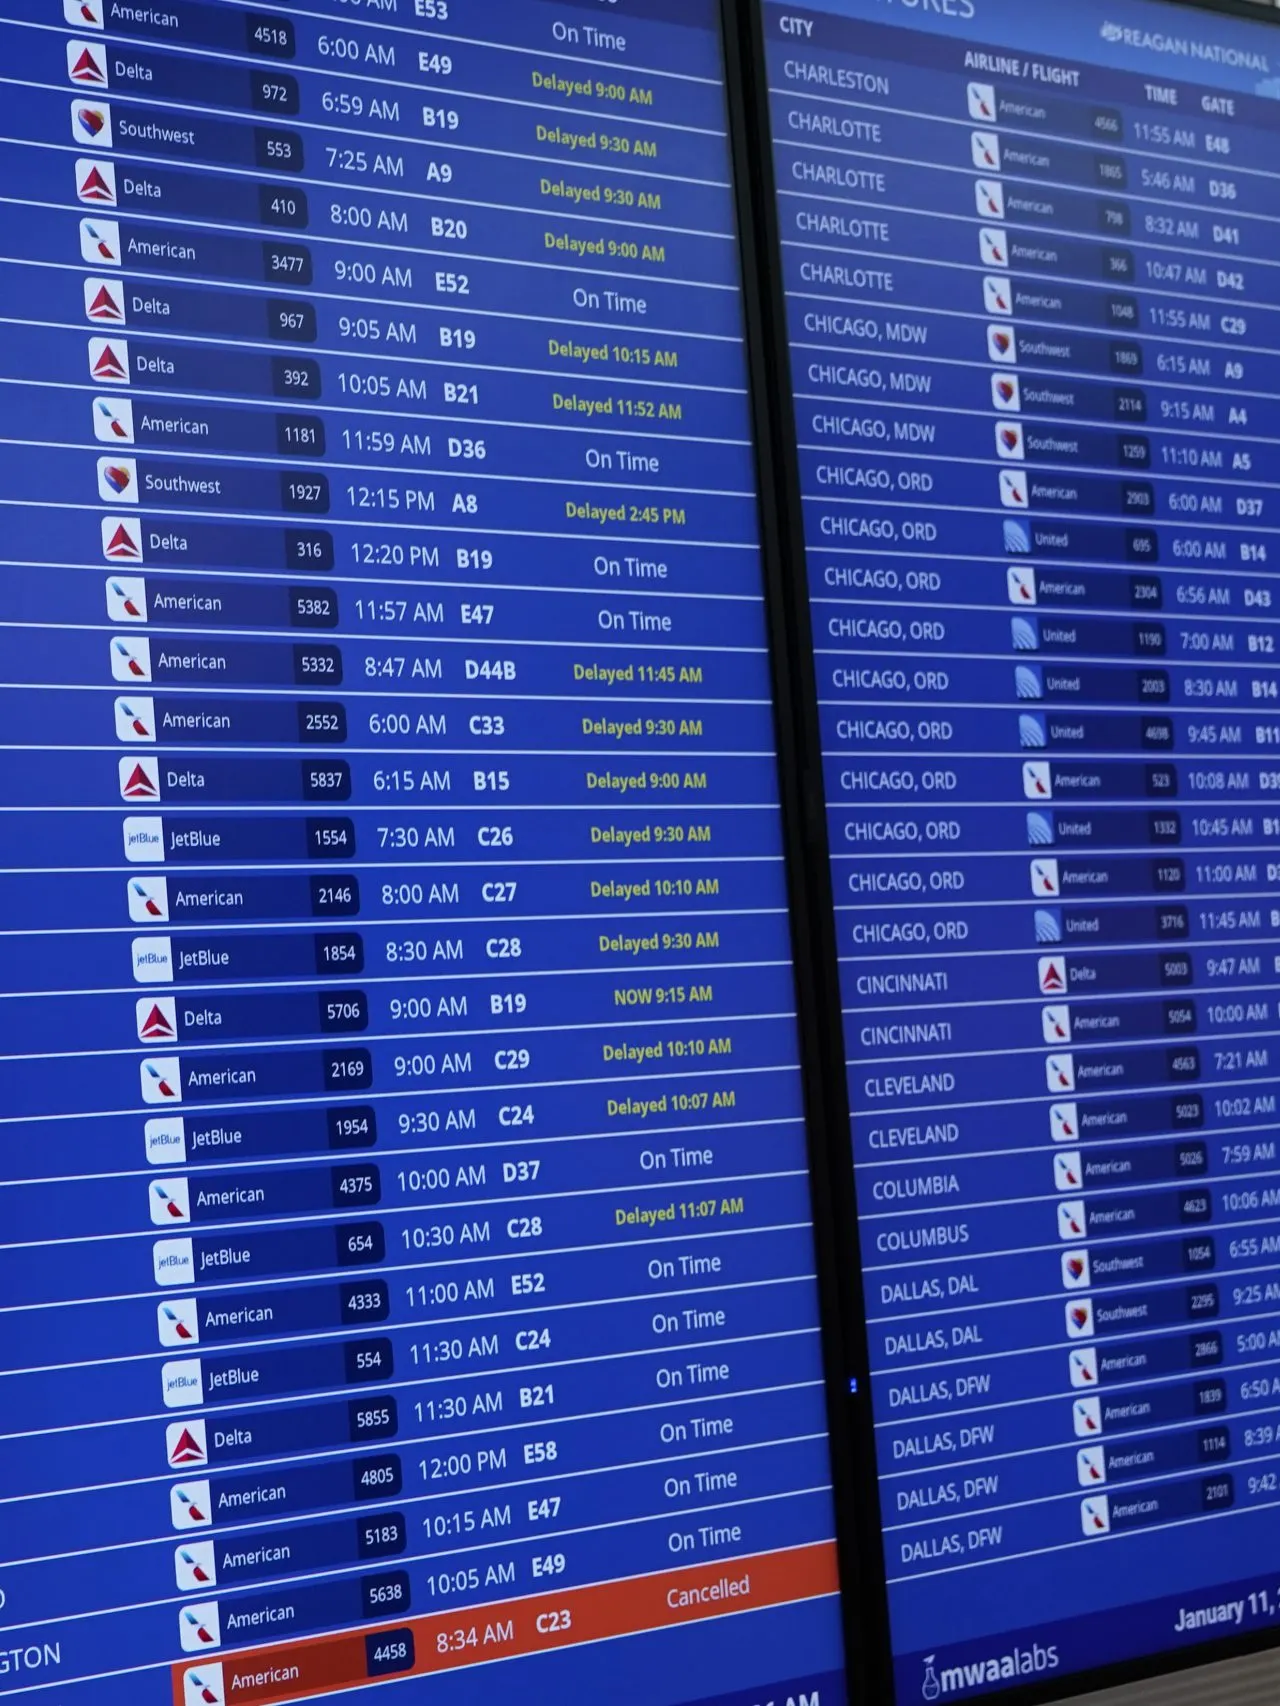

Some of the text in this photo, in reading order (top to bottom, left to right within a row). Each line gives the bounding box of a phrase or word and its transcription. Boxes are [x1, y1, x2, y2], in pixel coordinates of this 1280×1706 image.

[414, 0, 449, 20] E53
[552, 20, 579, 44] On
[582, 25, 627, 52] Time
[1123, 27, 1269, 73] REAGAN NATIONAL
[110, 2, 653, 106] American 4518 6:00 AM E49 Delayed 9:00 AM
[779, 15, 814, 38] CITY
[963, 50, 1020, 77] AIRLINE
[1031, 63, 1080, 87] FLIGHT
[1144, 83, 1178, 106] TIME
[1201, 95, 1235, 117] GATE
[783, 59, 890, 95] CHARLESTON
[999, 99, 1046, 118] American
[1134, 122, 1171, 144] 11:55
[1173, 129, 1195, 147] AM
[119, 119, 662, 210] Southwest 553 7:25 AM A9 Delayed 9:30 AM
[811, 414, 891, 442] CHICAGO,
[893, 421, 936, 443] MDW
[1027, 435, 1079, 453] Southwest
[1161, 446, 1199, 466] 11:10
[1200, 449, 1223, 468] AM
[1231, 452, 1252, 471] A5
[157, 652, 703, 686] American 5332 8:47 AM D44B Delayed 11:45 AM
[170, 829, 221, 851] JetBlue
[314, 829, 348, 846] 1554
[376, 826, 419, 848] 7:30
[423, 826, 455, 848] AM
[477, 826, 514, 847] C26
[590, 824, 652, 848] Delayed
[653, 825, 685, 843] 9:30
[686, 824, 712, 842] AM
[848, 871, 927, 893] CHICAGO,
[929, 870, 965, 891] ORD
[1062, 871, 1109, 884] American
[1195, 864, 1233, 883] 11:00
[1234, 863, 1257, 882] AM
[856, 971, 949, 995] CINCINNATI
[1070, 966, 1097, 981] Delta
[1206, 957, 1236, 977] 9:47
[1237, 956, 1261, 975] AM
[184, 984, 713, 1027] Delta 5706 9:00 AM B19 NOW 9:15 AM
[868, 1123, 960, 1149] CLEVELAND
[1081, 1112, 1128, 1126] American
[1214, 1097, 1252, 1117] 10:02
[1253, 1095, 1276, 1114] AM
[872, 1174, 961, 1201] COLUMBIA
[199, 1247, 251, 1271] JetBlue
[347, 1234, 374, 1253] 654
[401, 1224, 455, 1250] 10:30
[459, 1220, 491, 1245] AM
[506, 1215, 543, 1239] C28
[615, 1202, 676, 1228] Delayed
[678, 1199, 717, 1220] 11:07
[719, 1196, 745, 1216] AM
[876, 1223, 970, 1253] COLUMBUS
[880, 1278, 945, 1305] DALLAS,
[947, 1273, 980, 1296] DAL
[1092, 1256, 1144, 1274] Southwest
[1229, 1237, 1259, 1259] 6:55
[214, 1363, 730, 1449] Delta 5855 11:30 AM B21 On Time
[897, 1436, 1226, 1511] DALLAS, DFW American 1114
[226, 1605, 295, 1630] American
[369, 1583, 403, 1604] 5638
[426, 1567, 480, 1597] 10:05
[484, 1561, 516, 1587] AM
[531, 1552, 566, 1578] E49
[667, 1532, 695, 1553] On
[697, 1525, 742, 1548] Time
[231, 1573, 751, 1691] American 4458 8:34 AM C23 Cancelled
[1174, 1600, 1245, 1632] January
[1248, 1590, 1275, 1616] 11,
[941, 1643, 1059, 1692] mwaalabs
